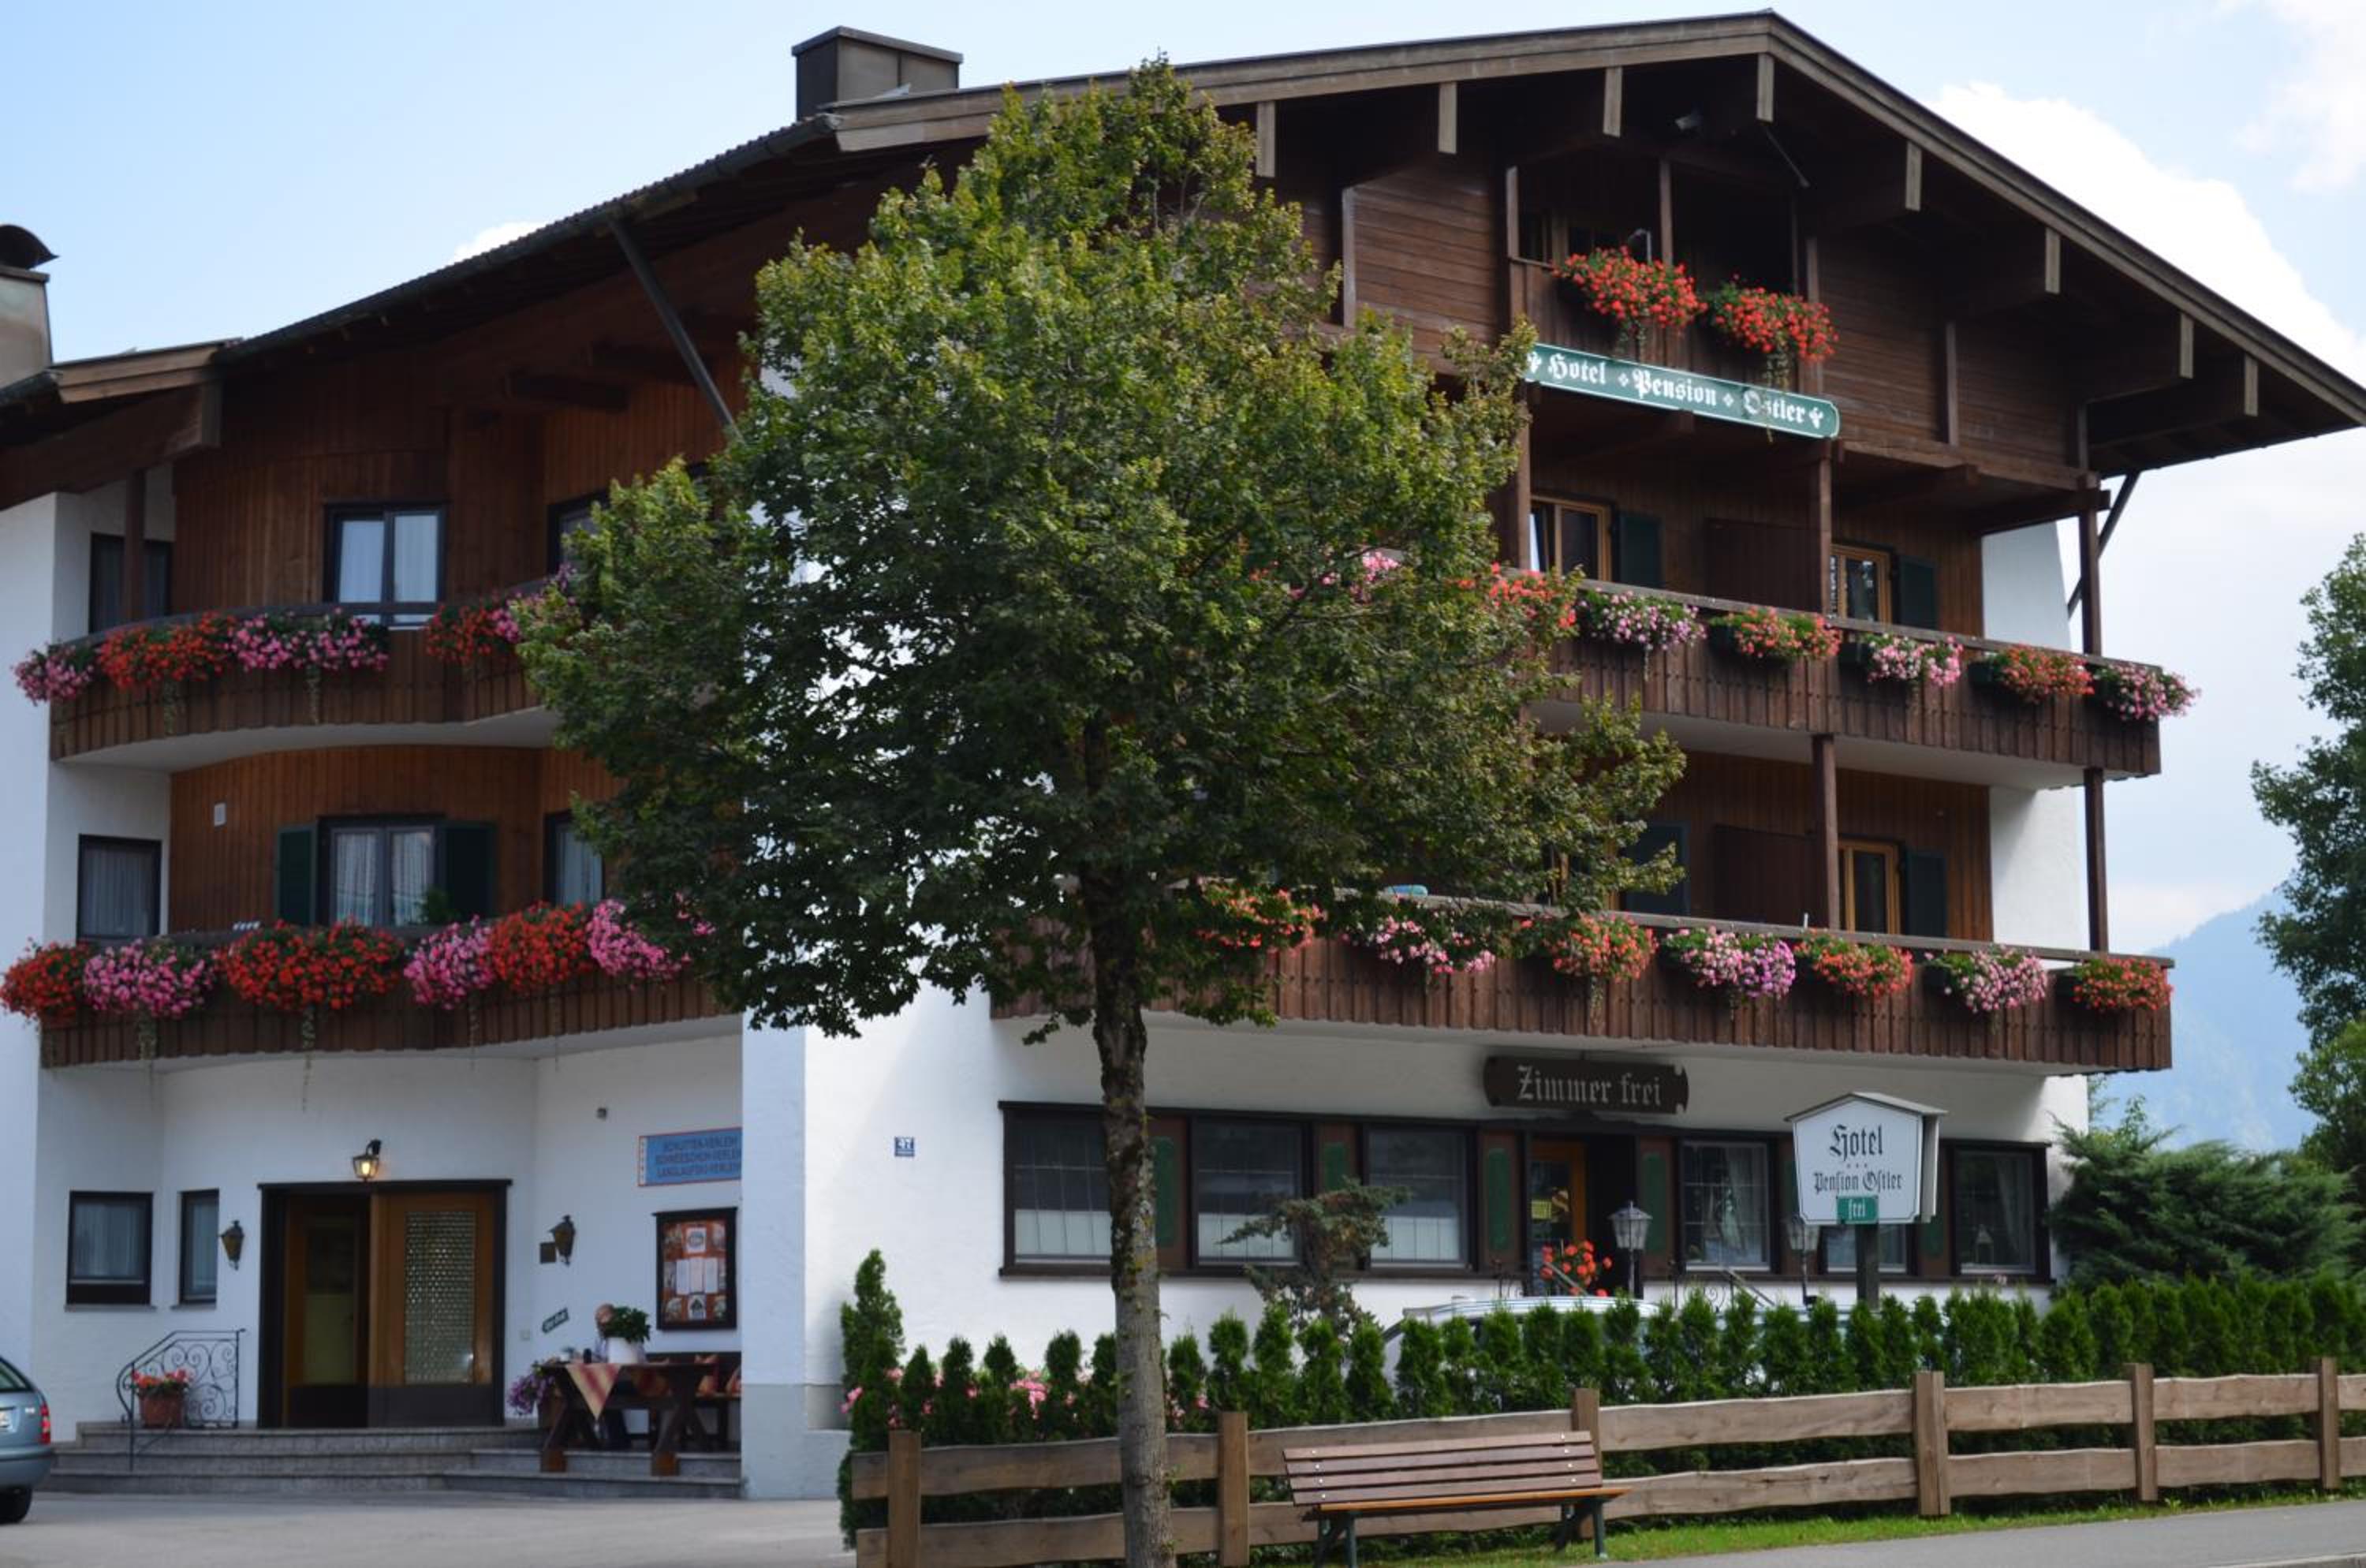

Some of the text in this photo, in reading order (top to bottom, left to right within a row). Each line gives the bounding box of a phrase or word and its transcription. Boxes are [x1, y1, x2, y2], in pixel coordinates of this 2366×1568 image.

[1547, 353, 1806, 424] Hotel Pension Ostler
[1517, 1065, 1662, 1106] Zimmer frei
[1829, 1124, 1883, 1162] Hotel
